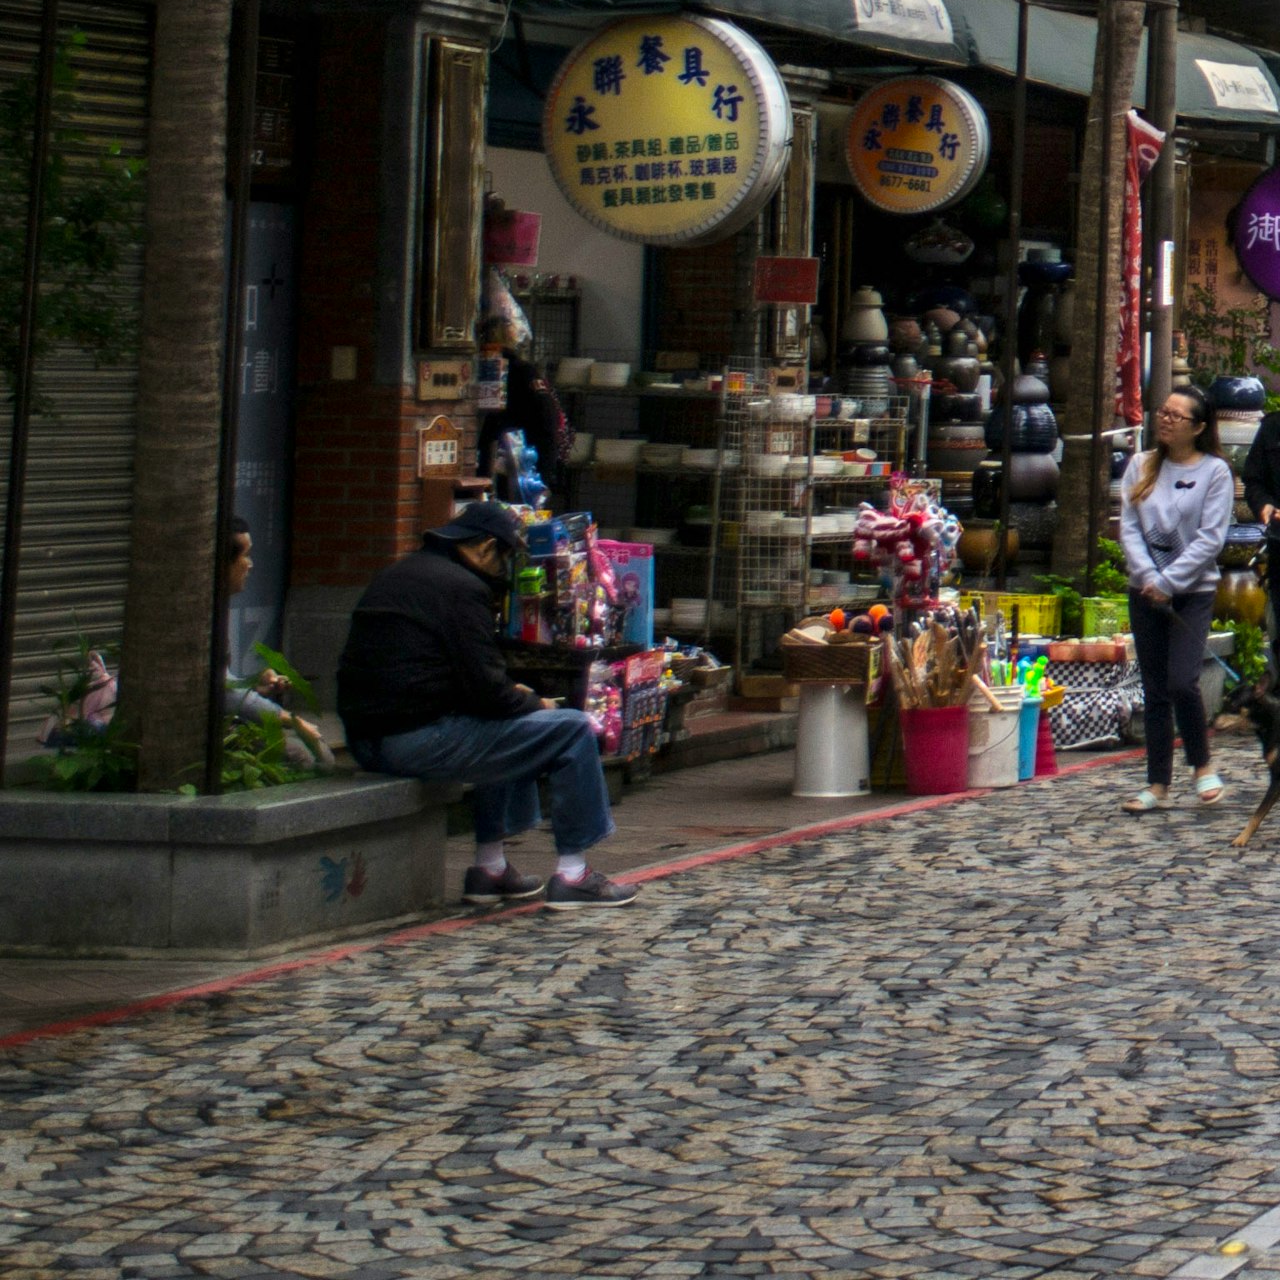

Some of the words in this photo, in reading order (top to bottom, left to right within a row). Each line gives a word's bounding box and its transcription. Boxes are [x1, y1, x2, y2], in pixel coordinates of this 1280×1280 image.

[565, 34, 744, 136] 永聯餐具行
